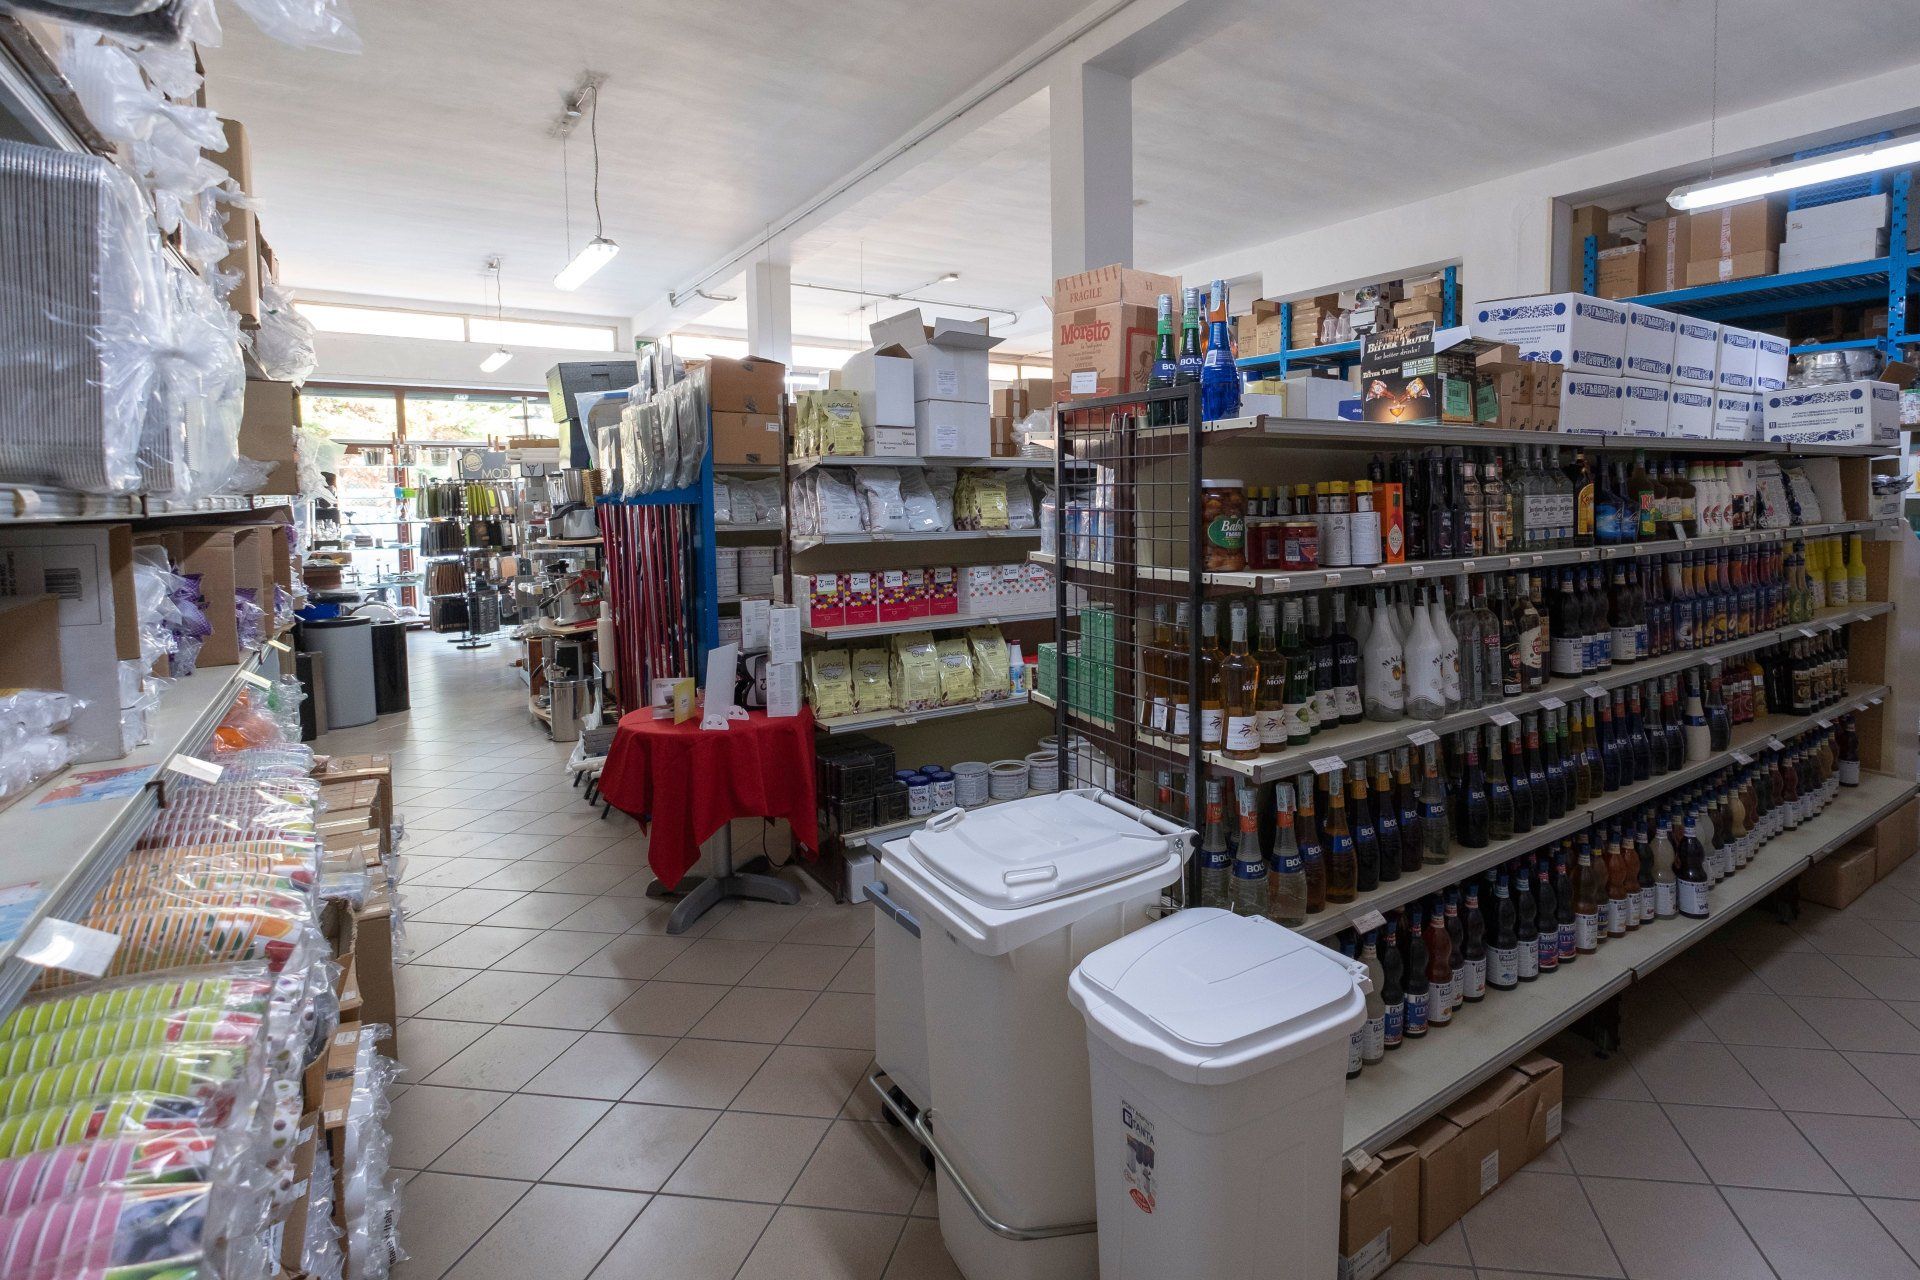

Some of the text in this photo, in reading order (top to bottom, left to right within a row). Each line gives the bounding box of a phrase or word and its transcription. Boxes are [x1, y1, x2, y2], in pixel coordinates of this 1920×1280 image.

[1070, 287, 1102, 303] FRAGILE
[1061, 320, 1110, 345] Moretto
[1400, 334, 1430, 346] TRUTH
[1180, 357, 1203, 366] BOLS
[383, 1208, 395, 1231] Italy
